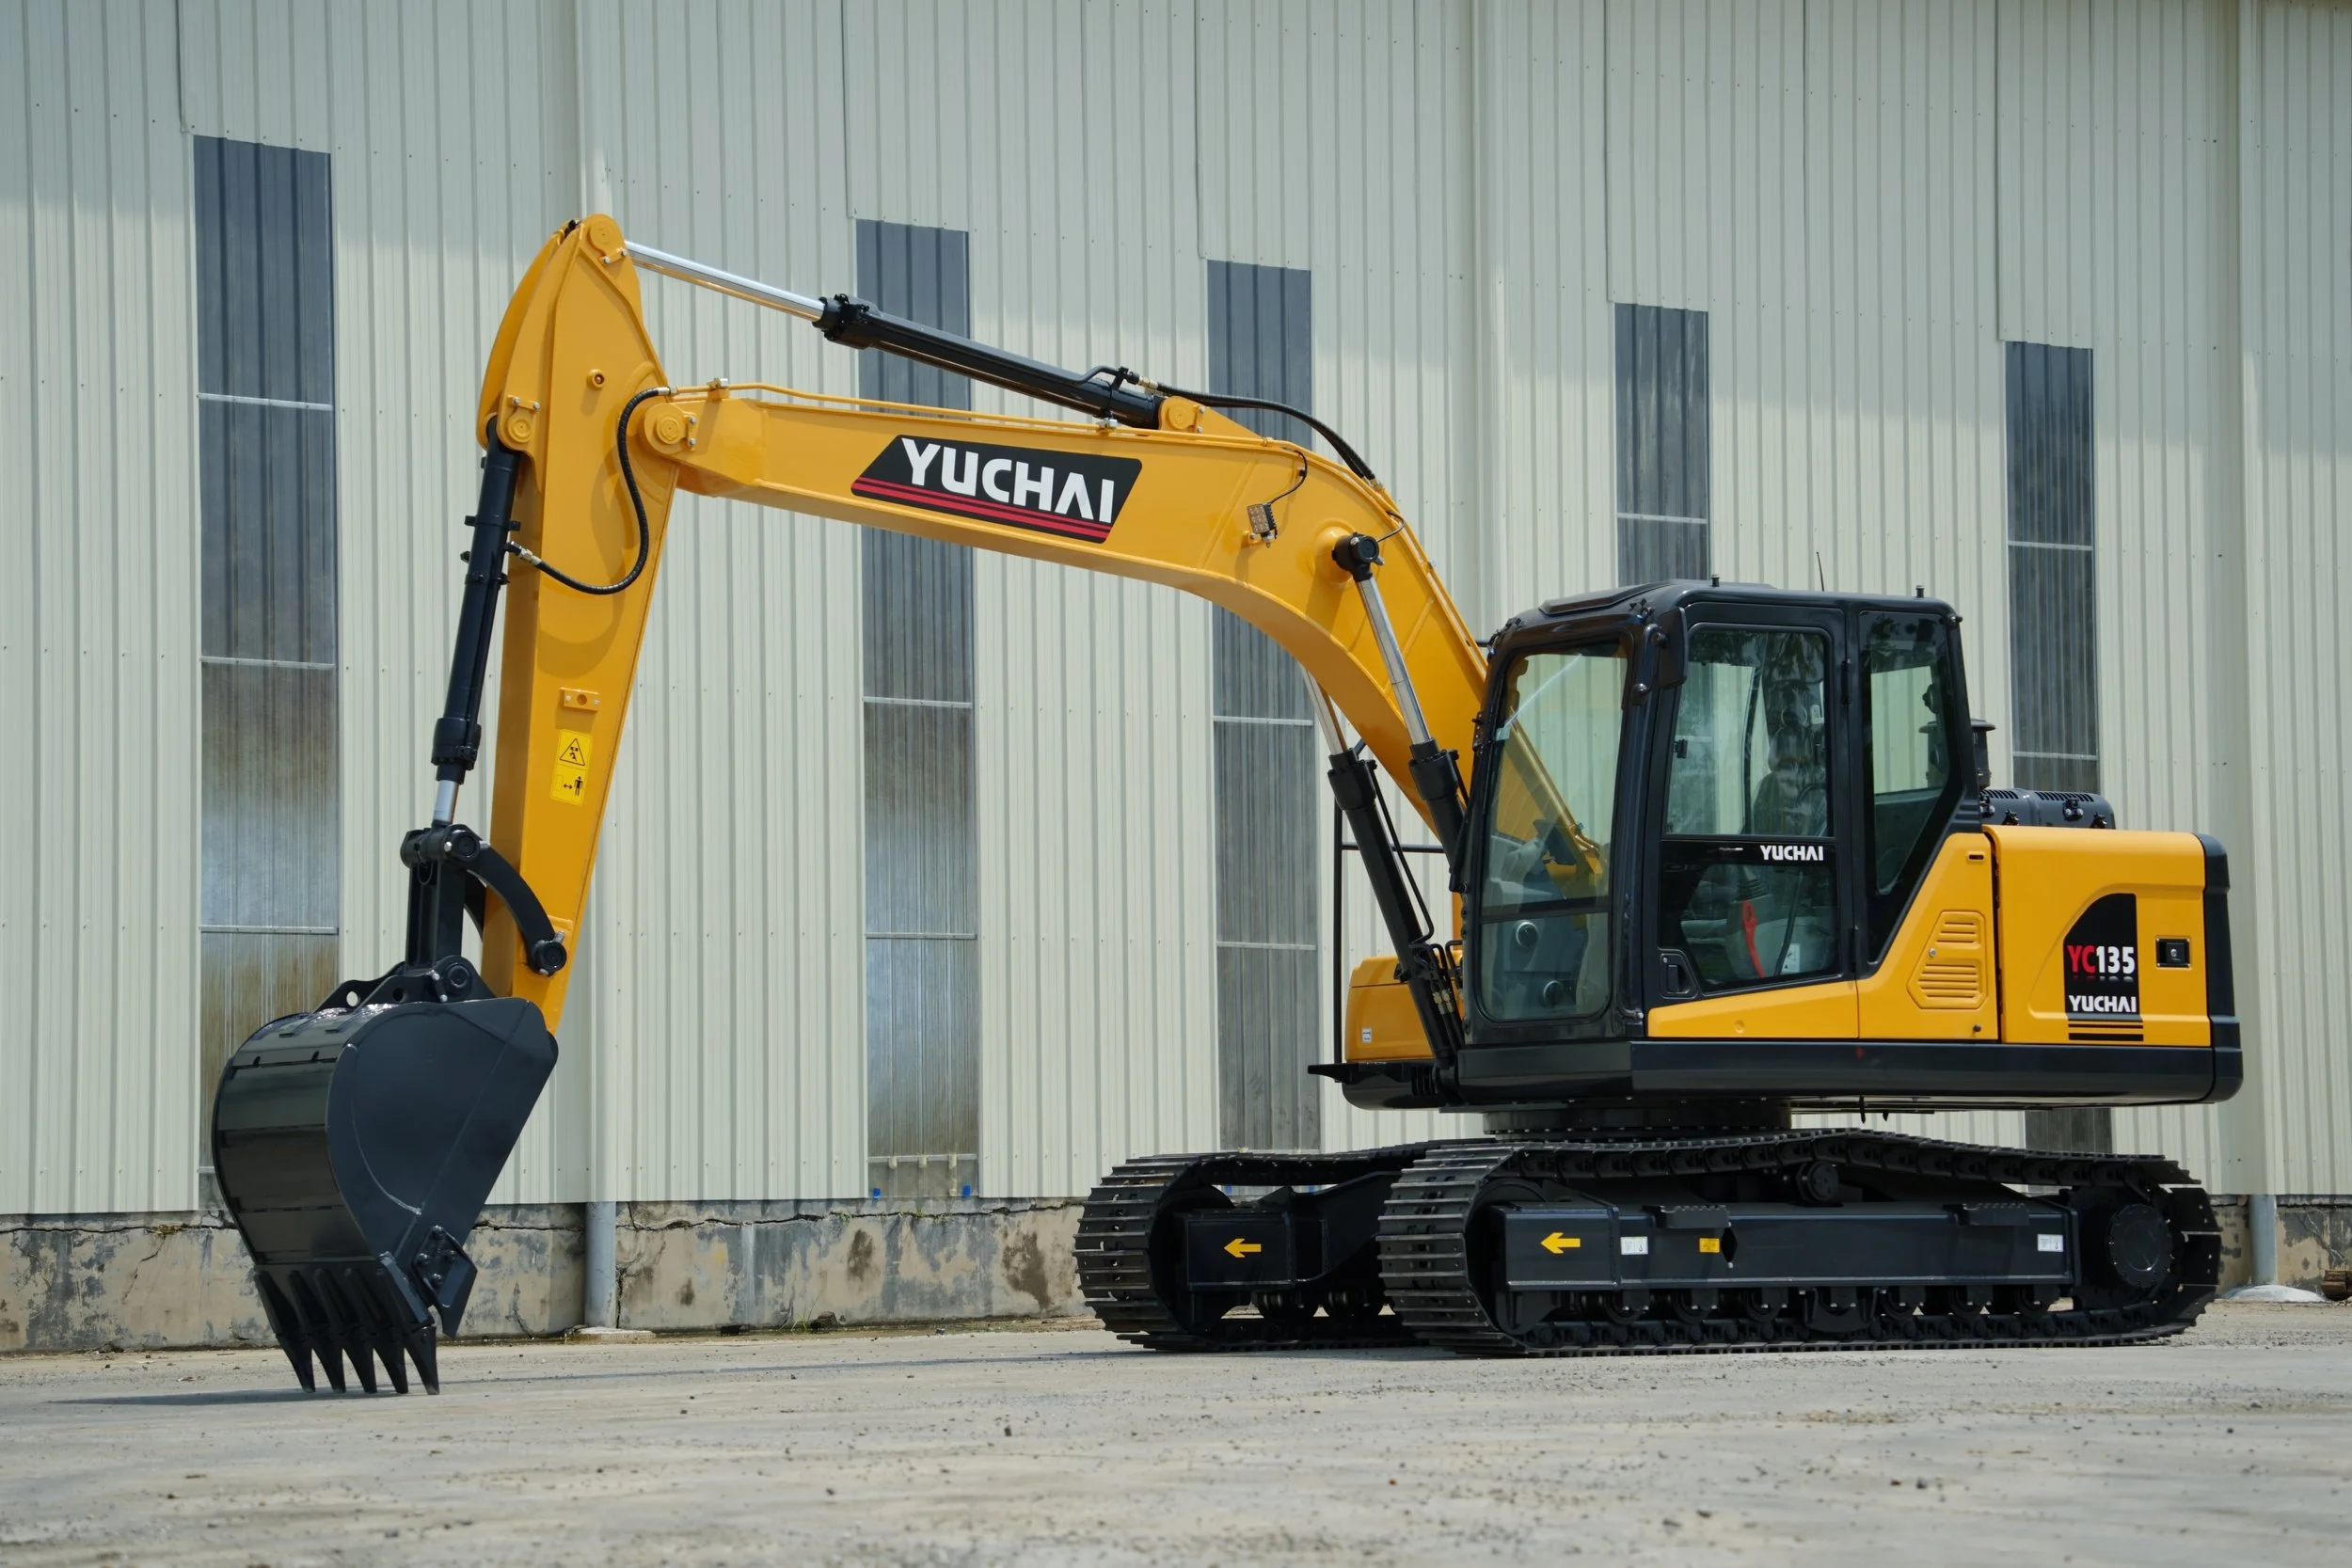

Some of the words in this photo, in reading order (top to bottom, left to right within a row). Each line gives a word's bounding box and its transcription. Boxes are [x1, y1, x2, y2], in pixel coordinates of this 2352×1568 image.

[901, 437, 1114, 523] YUCHAI
[1760, 845, 1823, 861] YUCHAI
[2067, 944, 2135, 974] YC135
[2069, 995, 2136, 1012] YUCHAI
